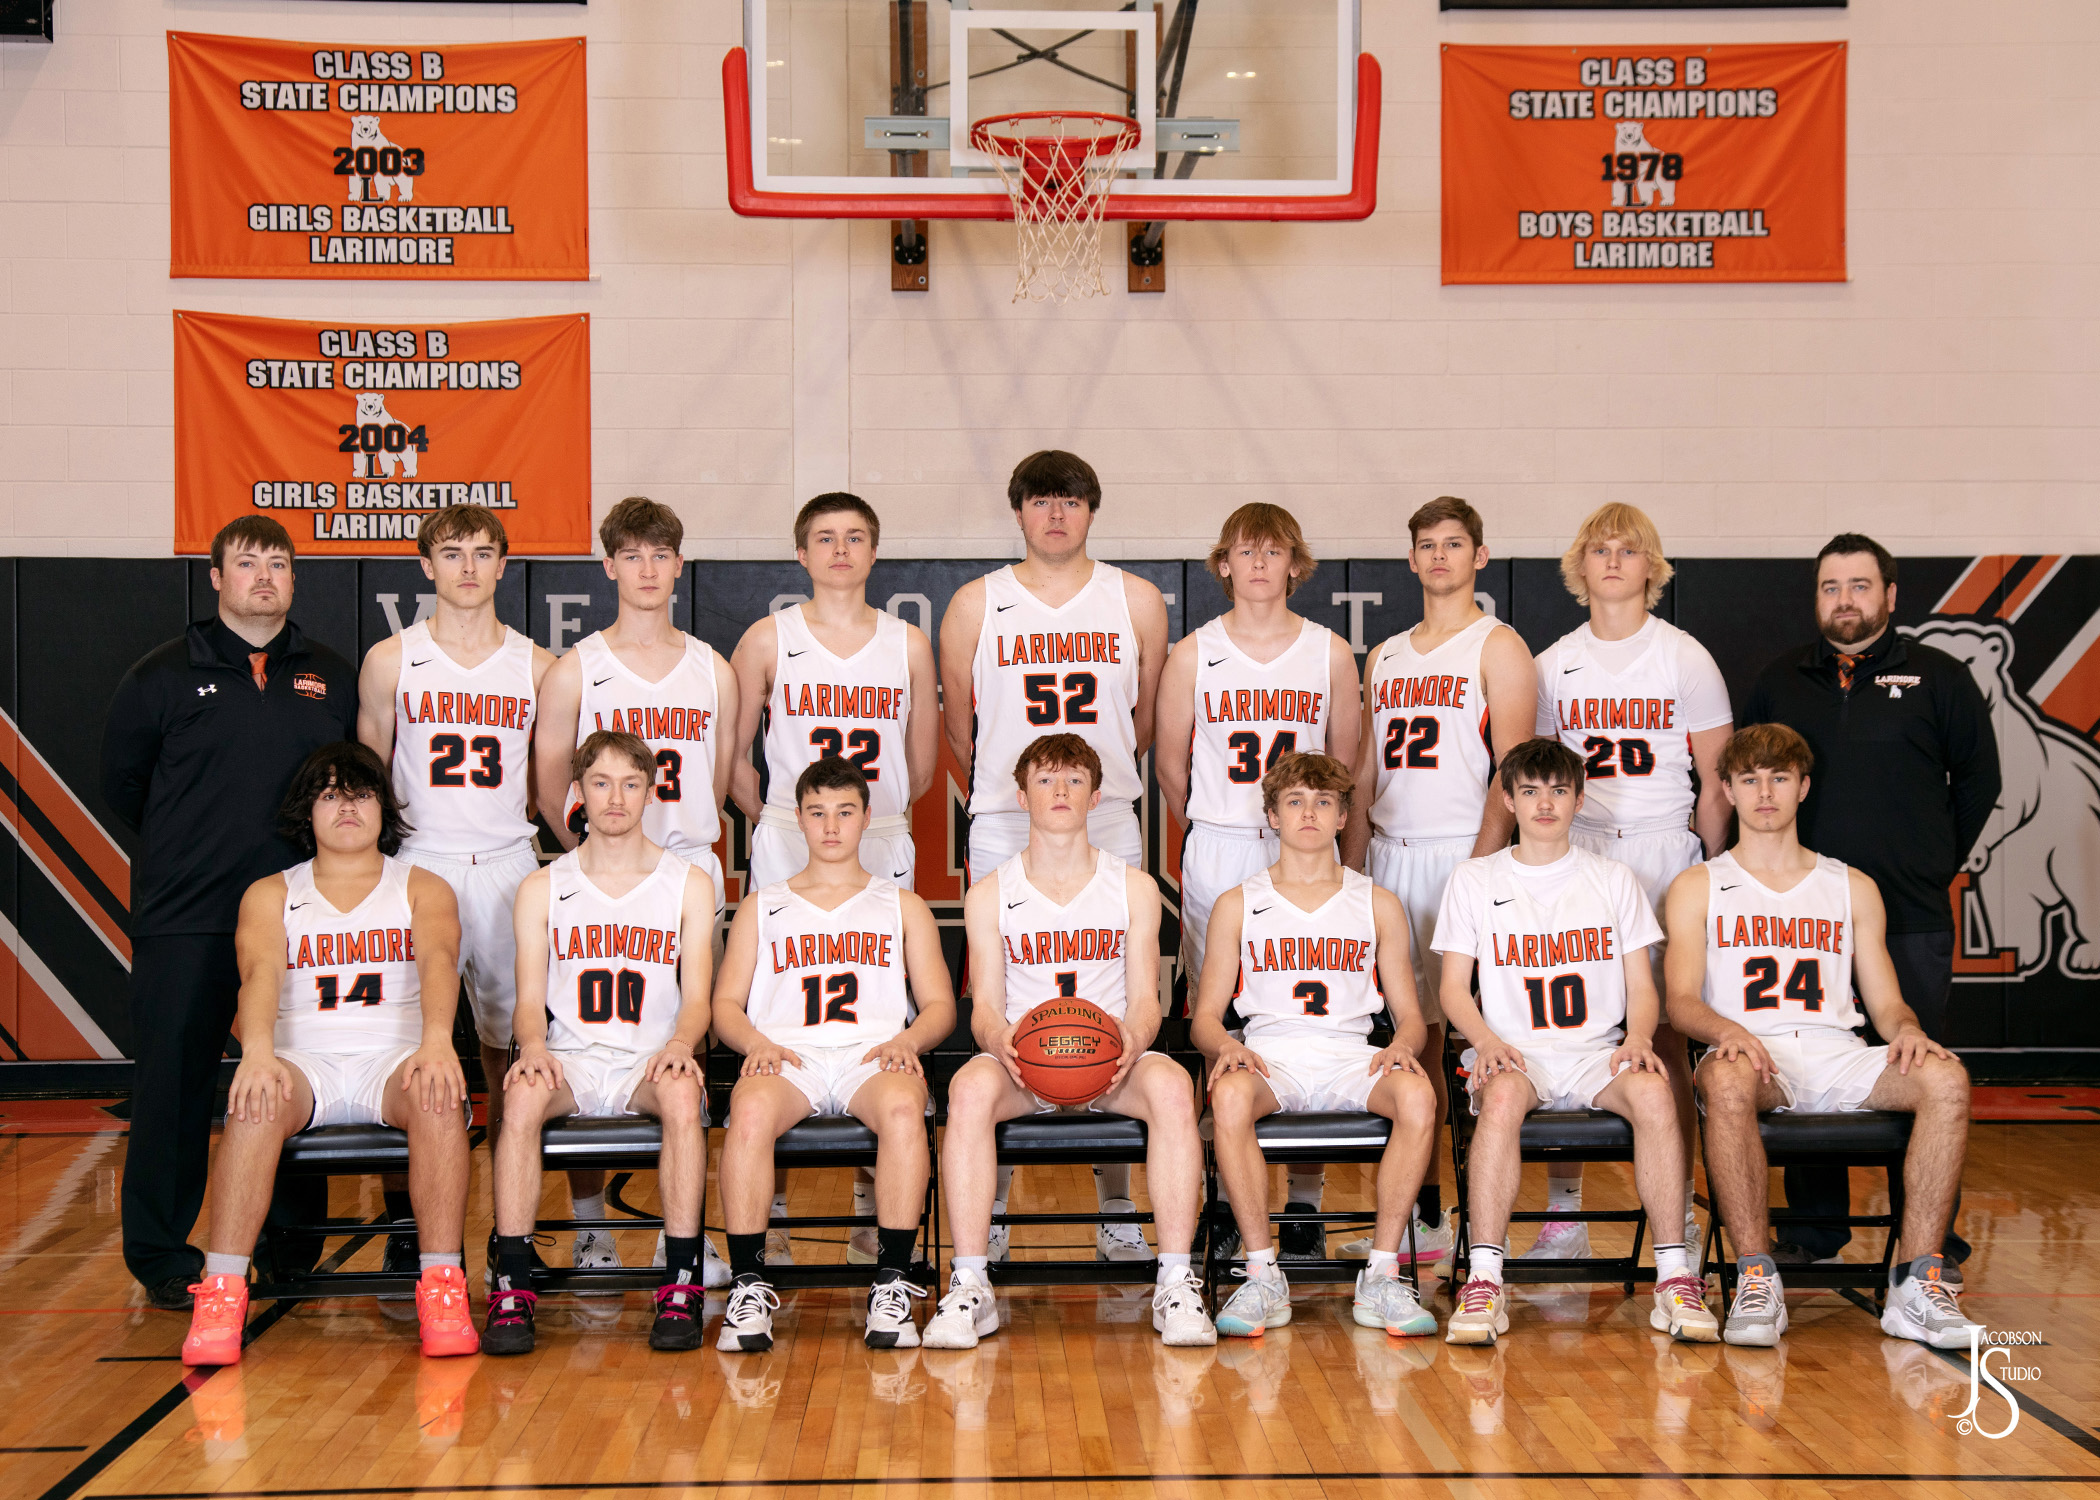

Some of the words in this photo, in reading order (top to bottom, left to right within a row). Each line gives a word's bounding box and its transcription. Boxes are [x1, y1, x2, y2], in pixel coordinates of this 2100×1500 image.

[313, 50, 412, 81] CLASS
[421, 51, 444, 81] B
[1580, 57, 1675, 88] CLASS
[1685, 56, 1706, 87] B
[240, 80, 330, 112] STATE
[338, 82, 518, 114] CHAMPIONS
[1509, 89, 1594, 120] STATE
[1603, 88, 1778, 119] CHAMPIONS
[333, 146, 425, 176] 2003
[1601, 153, 1684, 182] 1978
[247, 203, 333, 232] GIRLS
[342, 205, 514, 234] BASKETBALL
[1518, 210, 1593, 239] BOYS
[1602, 208, 1770, 238] BASKETBALL
[309, 236, 455, 265] LARIMORE
[1573, 240, 1714, 270] LARIMORE
[318, 329, 417, 359] CLASS
[426, 330, 449, 360] B
[246, 359, 335, 390] STATE
[343, 360, 521, 391] CHAMPIONS
[338, 424, 430, 454] 2004
[252, 481, 337, 509] GIRLS
[345, 481, 518, 510] BASKETBALL
[314, 512, 427, 541] LARIMO
[997, 632, 1121, 667] LARIMORE
[1373, 675, 1469, 714] LARIMORE
[1874, 674, 1922, 685] LARIMORE
[403, 691, 531, 730] LARIMORE
[784, 684, 903, 720] LARIMORE
[1023, 671, 1098, 727] 52
[1204, 689, 1323, 725] LARIMORE
[1558, 698, 1676, 730] LARIMORE
[809, 726, 881, 782] 32
[1384, 716, 1441, 770] 22
[1582, 735, 1656, 780] 20
[429, 733, 503, 789] 23
[553, 923, 676, 965] LARIMORE
[1004, 929, 1125, 965] LARIMORE
[1492, 926, 1614, 968] LARIMORE
[1717, 915, 1843, 954] LARIMORE
[771, 931, 892, 974] LARIMORE
[1248, 937, 1370, 972] LARIMORE
[315, 973, 386, 1011] 14
[577, 968, 647, 1026] 00
[801, 971, 859, 1027] 12
[1292, 980, 1330, 1017] 3
[1523, 972, 1588, 1030] 10
[1743, 955, 1825, 1012] 24
[1031, 1006, 1102, 1027] SPALDING
[1039, 1036, 1101, 1047] LEGACY
